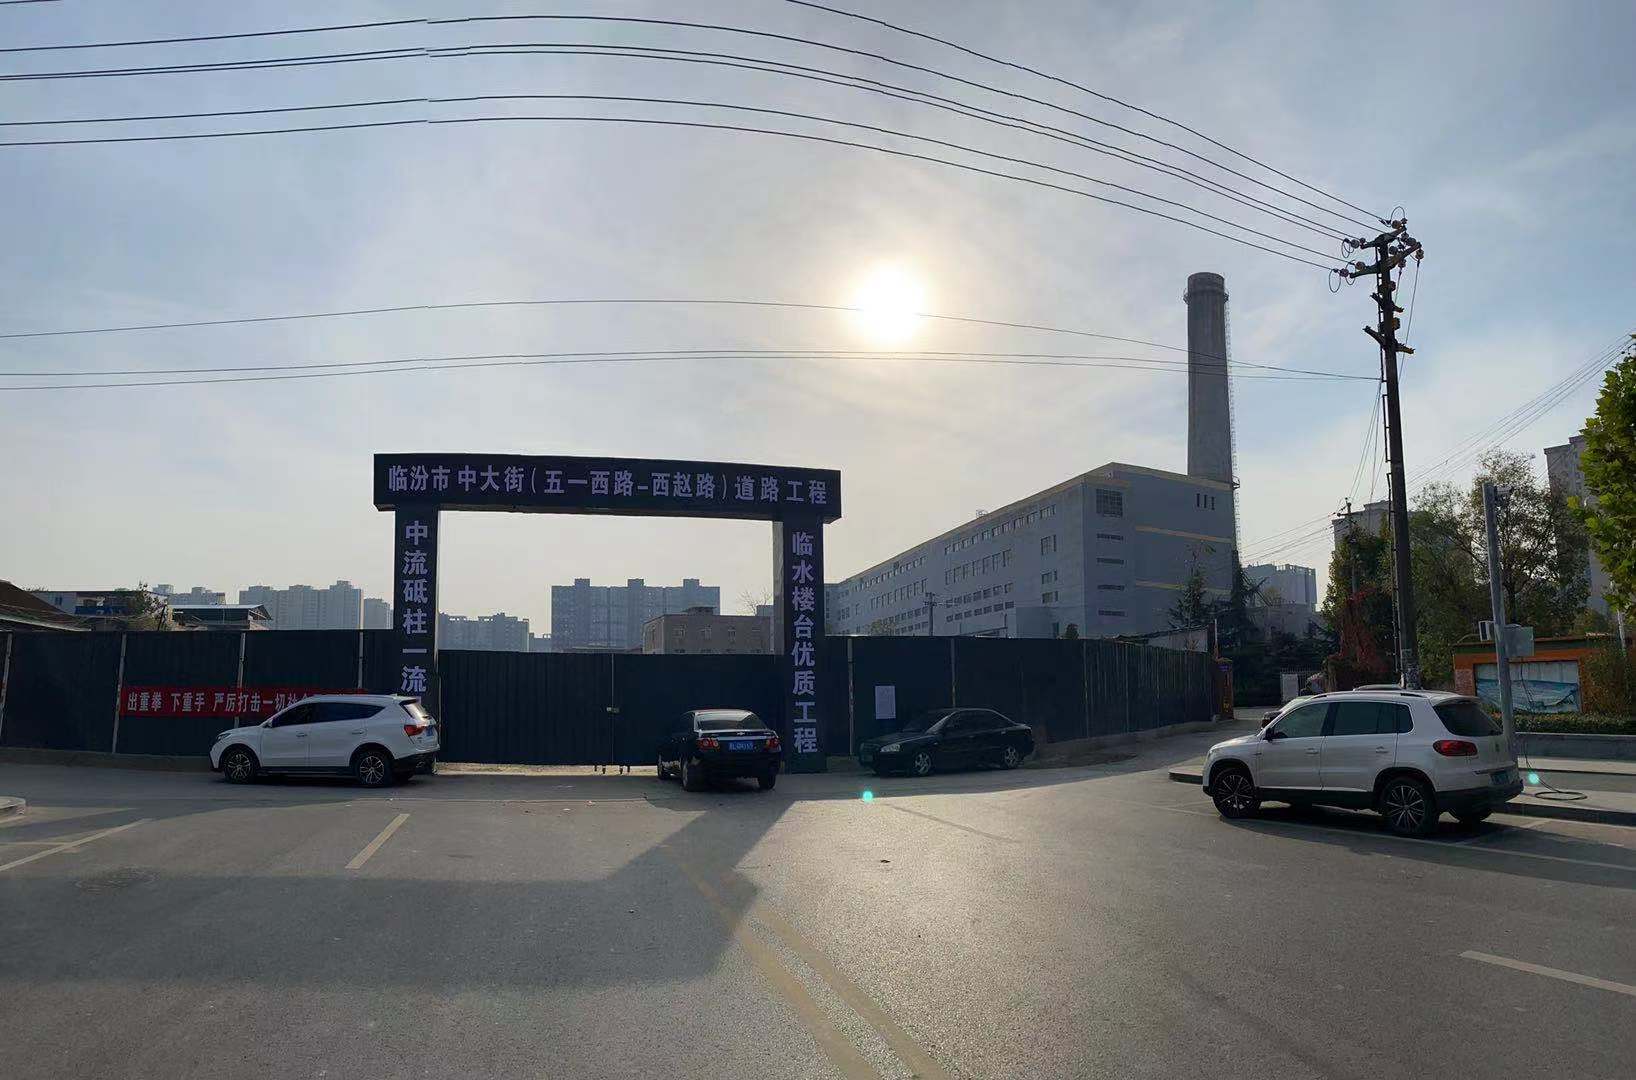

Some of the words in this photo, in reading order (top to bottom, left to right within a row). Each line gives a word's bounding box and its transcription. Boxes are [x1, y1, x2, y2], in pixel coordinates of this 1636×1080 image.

[127, 691, 163, 712] 出重拳
[170, 691, 206, 713] 下重手
[400, 520, 429, 704] 中流砥柱一流
[791, 530, 818, 754] 临水楼台优质工程
